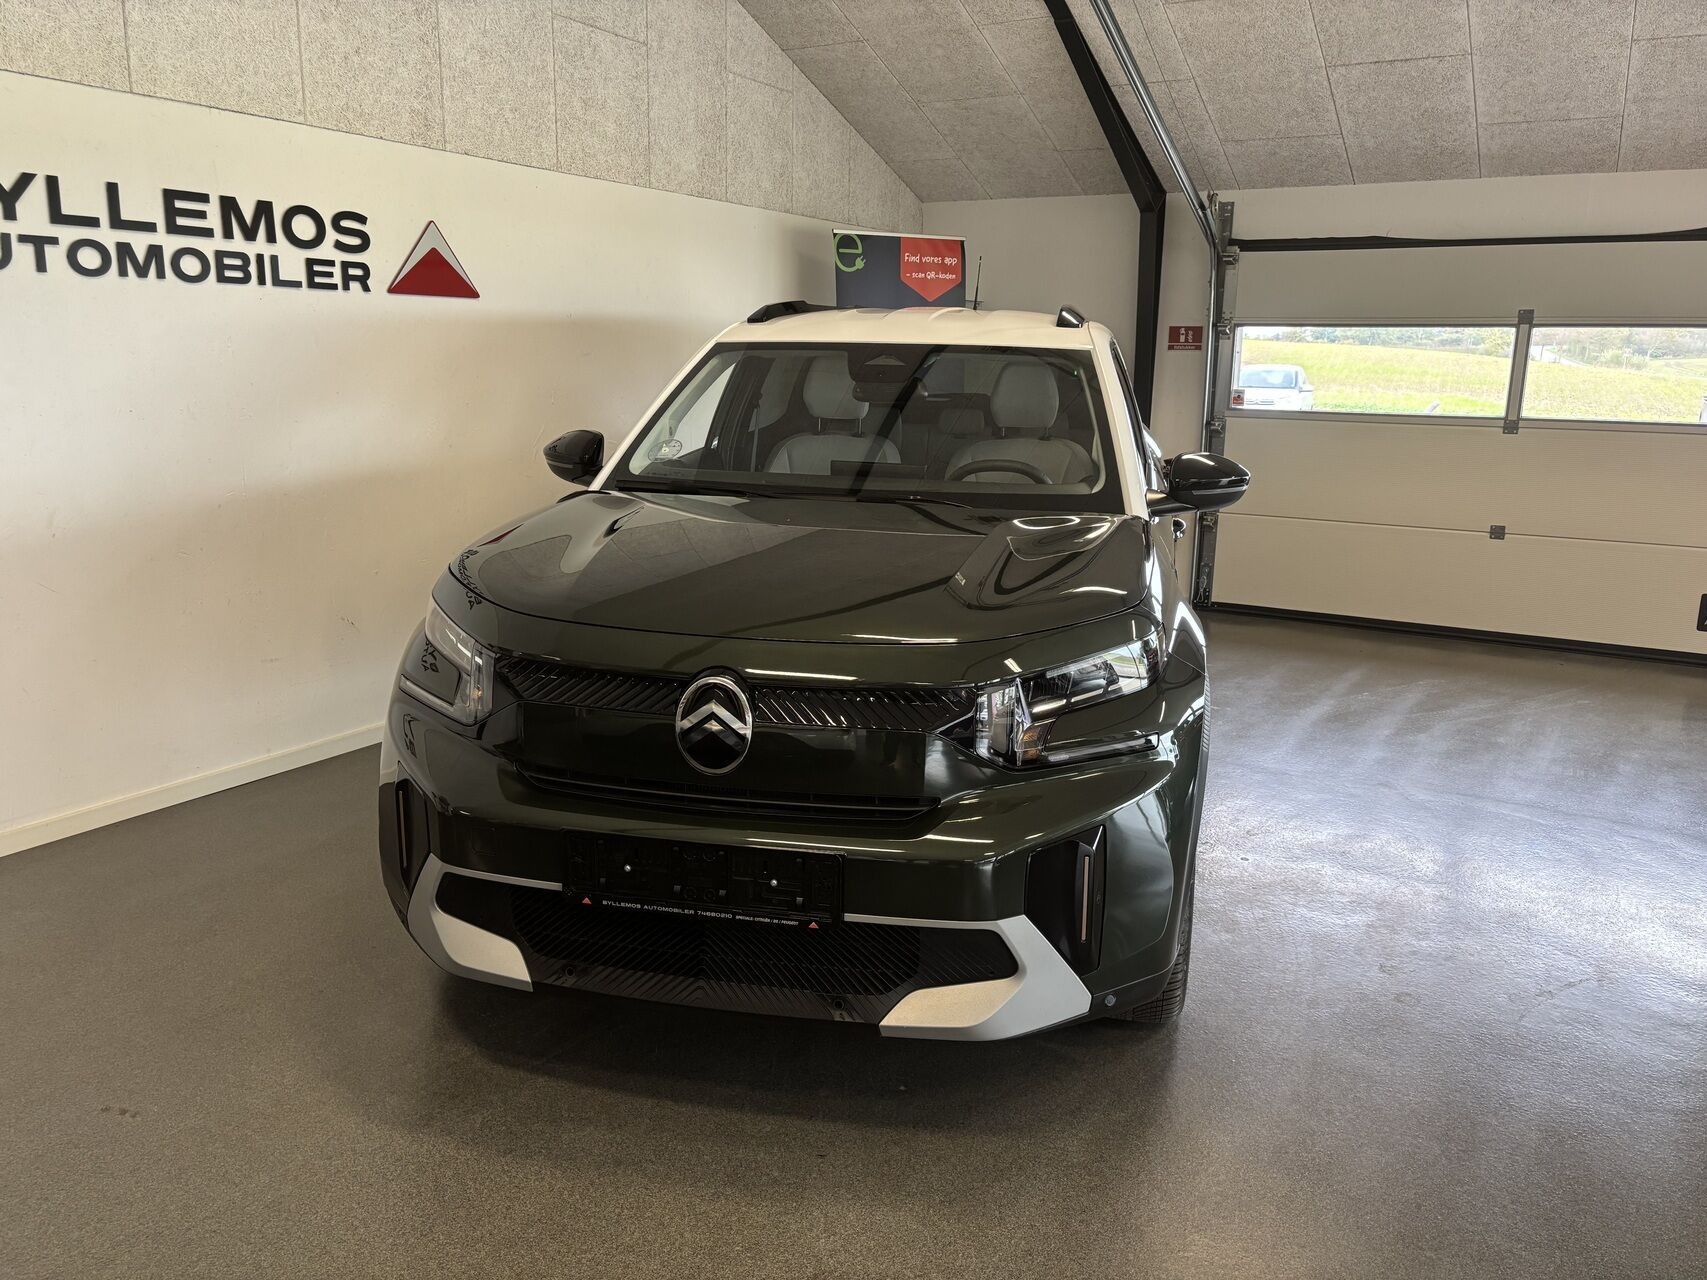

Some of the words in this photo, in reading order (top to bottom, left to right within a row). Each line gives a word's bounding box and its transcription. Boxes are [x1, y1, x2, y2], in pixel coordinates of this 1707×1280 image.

[904, 252, 920, 264] Find
[921, 255, 942, 265] vores
[943, 256, 958, 267] app
[911, 271, 926, 279] scan
[926, 271, 956, 280] QR-koden
[602, 899, 641, 909] BYLLEMOS
[643, 903, 695, 915] AUTOMOBILER
